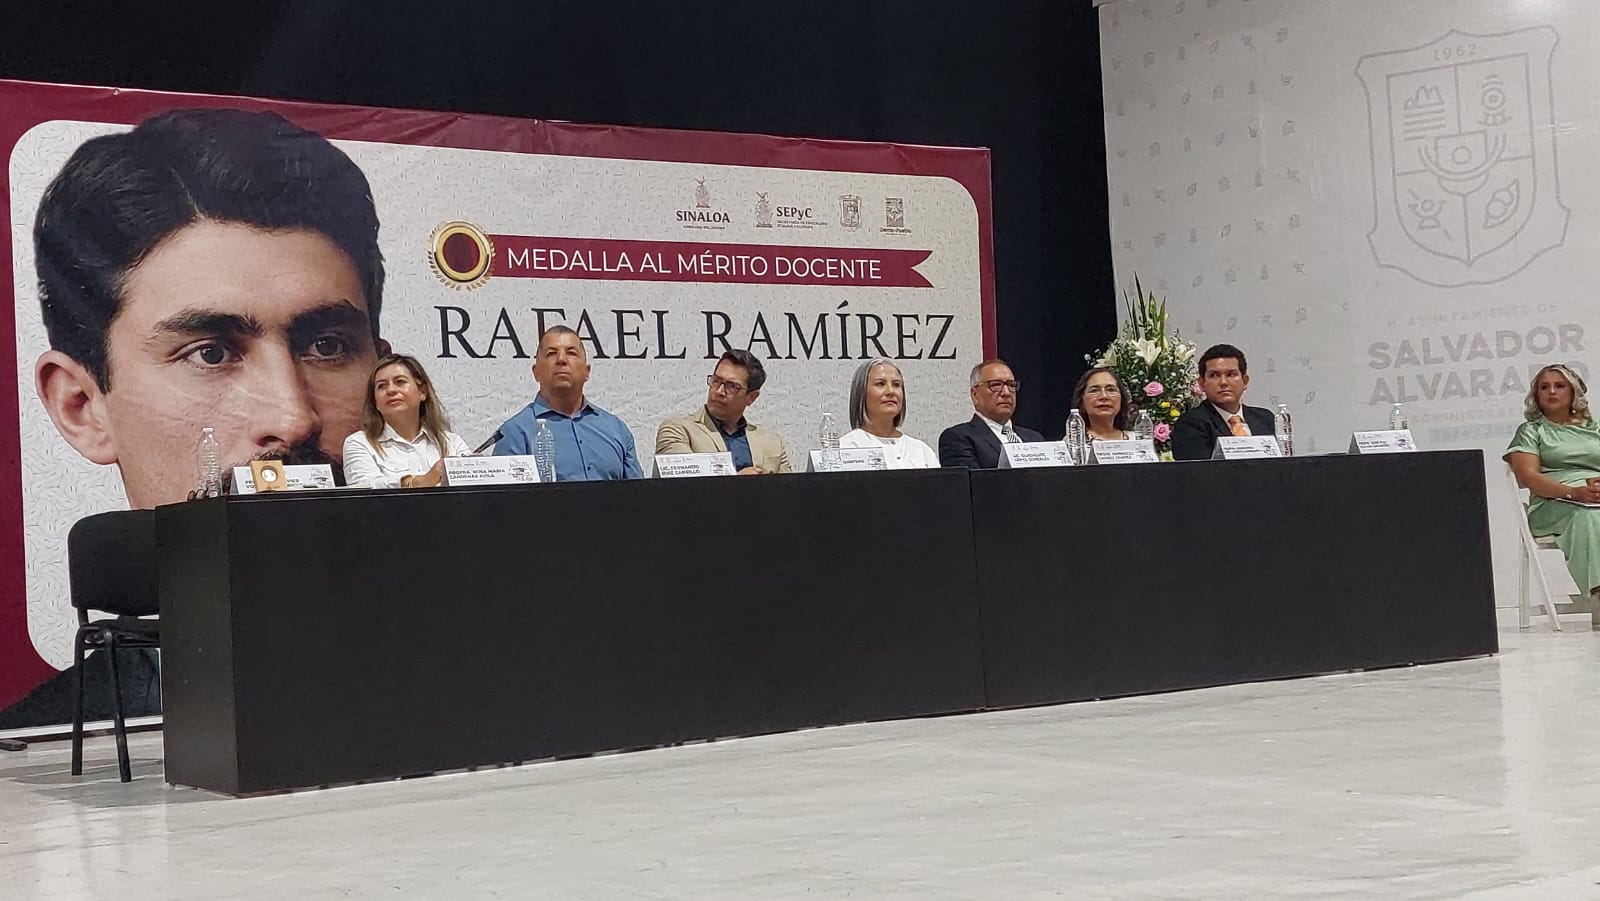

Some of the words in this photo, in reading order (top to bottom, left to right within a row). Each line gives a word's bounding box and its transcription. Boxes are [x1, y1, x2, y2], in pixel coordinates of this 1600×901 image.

[1433, 43, 1477, 61] 1962
[676, 210, 731, 223] SINALOA
[776, 206, 813, 220] SEPyC
[507, 248, 634, 273] MEDALLA
[639, 252, 672, 274] AL
[677, 250, 768, 276] MÉRITO
[775, 256, 882, 279] DOCENTE
[433, 305, 688, 360] RAFAEL
[700, 300, 958, 361] RAMÍREZ
[1367, 323, 1586, 370] SALVADOR
[1368, 360, 1590, 406] ALVARA
